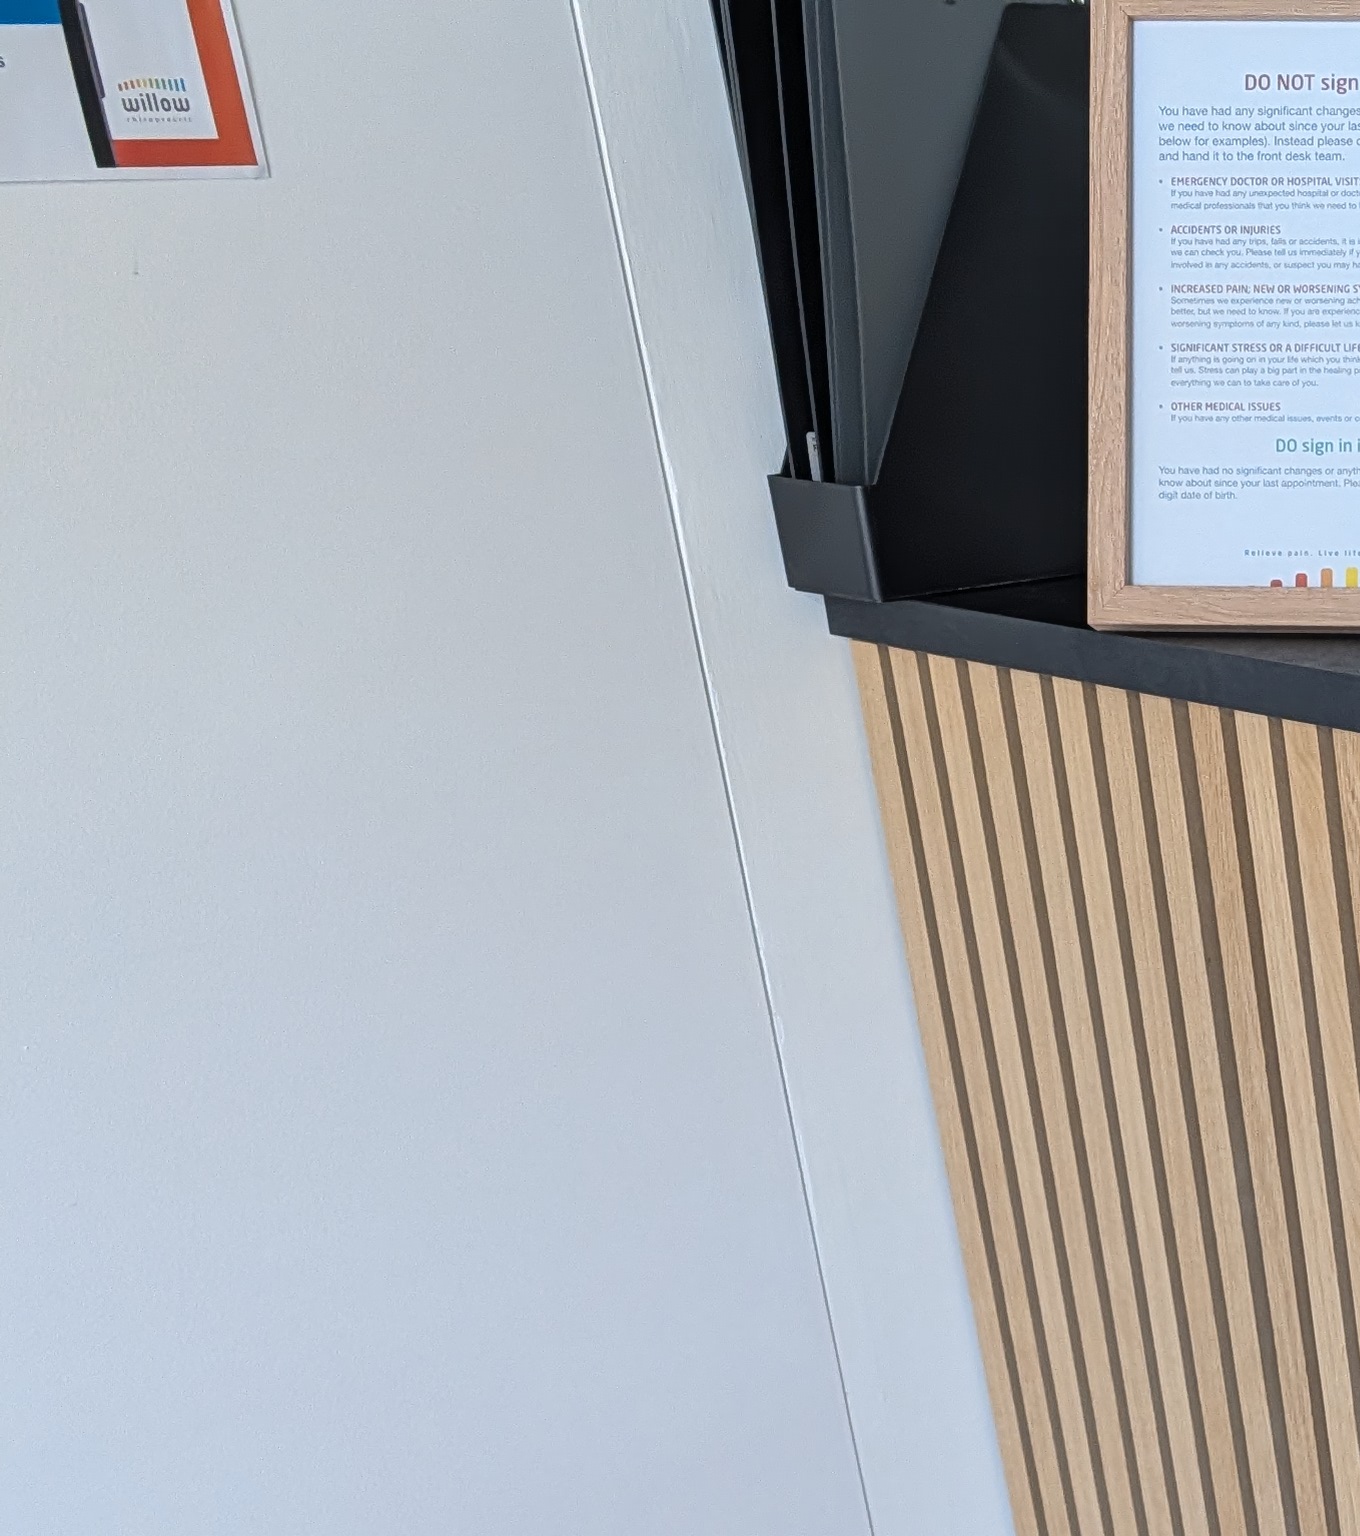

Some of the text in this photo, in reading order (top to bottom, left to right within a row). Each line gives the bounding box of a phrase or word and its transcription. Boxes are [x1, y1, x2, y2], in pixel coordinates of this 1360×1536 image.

[1245, 74, 1271, 91] DO
[1277, 74, 1315, 91] NOT
[1321, 73, 1359, 95] sign
[121, 93, 191, 113] willow
[1158, 106, 1179, 116] You
[1182, 106, 1208, 116] have
[1211, 106, 1232, 116] had
[1235, 107, 1255, 119] any
[1257, 105, 1313, 119] significant
[1158, 123, 1175, 132] we
[1178, 121, 1205, 132] need
[1208, 121, 1219, 131] to
[1222, 121, 1252, 131] know
[1254, 121, 1286, 131] about
[1289, 121, 1318, 131] since
[1320, 123, 1345, 134] your
[1159, 136, 1192, 146] below
[1194, 136, 1210, 147] for
[1212, 136, 1270, 148] examples).
[1274, 136, 1314, 146] Instead
[1317, 136, 1353, 148] please
[1159, 150, 1345, 161] and hand it to the front desk team.
[1171, 177, 1228, 186] EMERGENCY
[1230, 176, 1269, 186] DOCTOR
[1271, 176, 1285, 186] OR
[1287, 177, 1333, 186] HOSPITAL
[1170, 225, 1281, 236] ACCIDENTS OR INJURIES
[1171, 284, 1224, 294] INCREASED
[1253, 284, 1275, 294] NEW
[1277, 284, 1291, 294] OR
[1293, 284, 1350, 294] WORSENING
[1171, 343, 1230, 353] SIGNIFICANT
[1232, 343, 1267, 353] STRESS
[1269, 343, 1283, 353] OR
[1285, 343, 1292, 353] A
[1294, 343, 1341, 353] DIFFICULT
[1171, 402, 1281, 412] OTHER MEDICAL ISSUES
[1276, 438, 1297, 453] DO
[1302, 438, 1334, 456] sign
[1339, 438, 1352, 452] in
[1158, 466, 1176, 475] You
[1178, 466, 1200, 475] have
[1202, 466, 1220, 475] had
[1236, 466, 1282, 477] significant
[1284, 467, 1323, 478] changes
[1324, 468, 1335, 476] or
[1158, 478, 1184, 488] know
[1185, 479, 1212, 487] about
[1214, 480, 1239, 488] since
[1240, 480, 1261, 489] your
[1263, 479, 1279, 488] last
[1281, 479, 1341, 489] appointment.
[1158, 491, 1237, 501] digit date of birth.
[1244, 549, 1282, 557] Relieve
